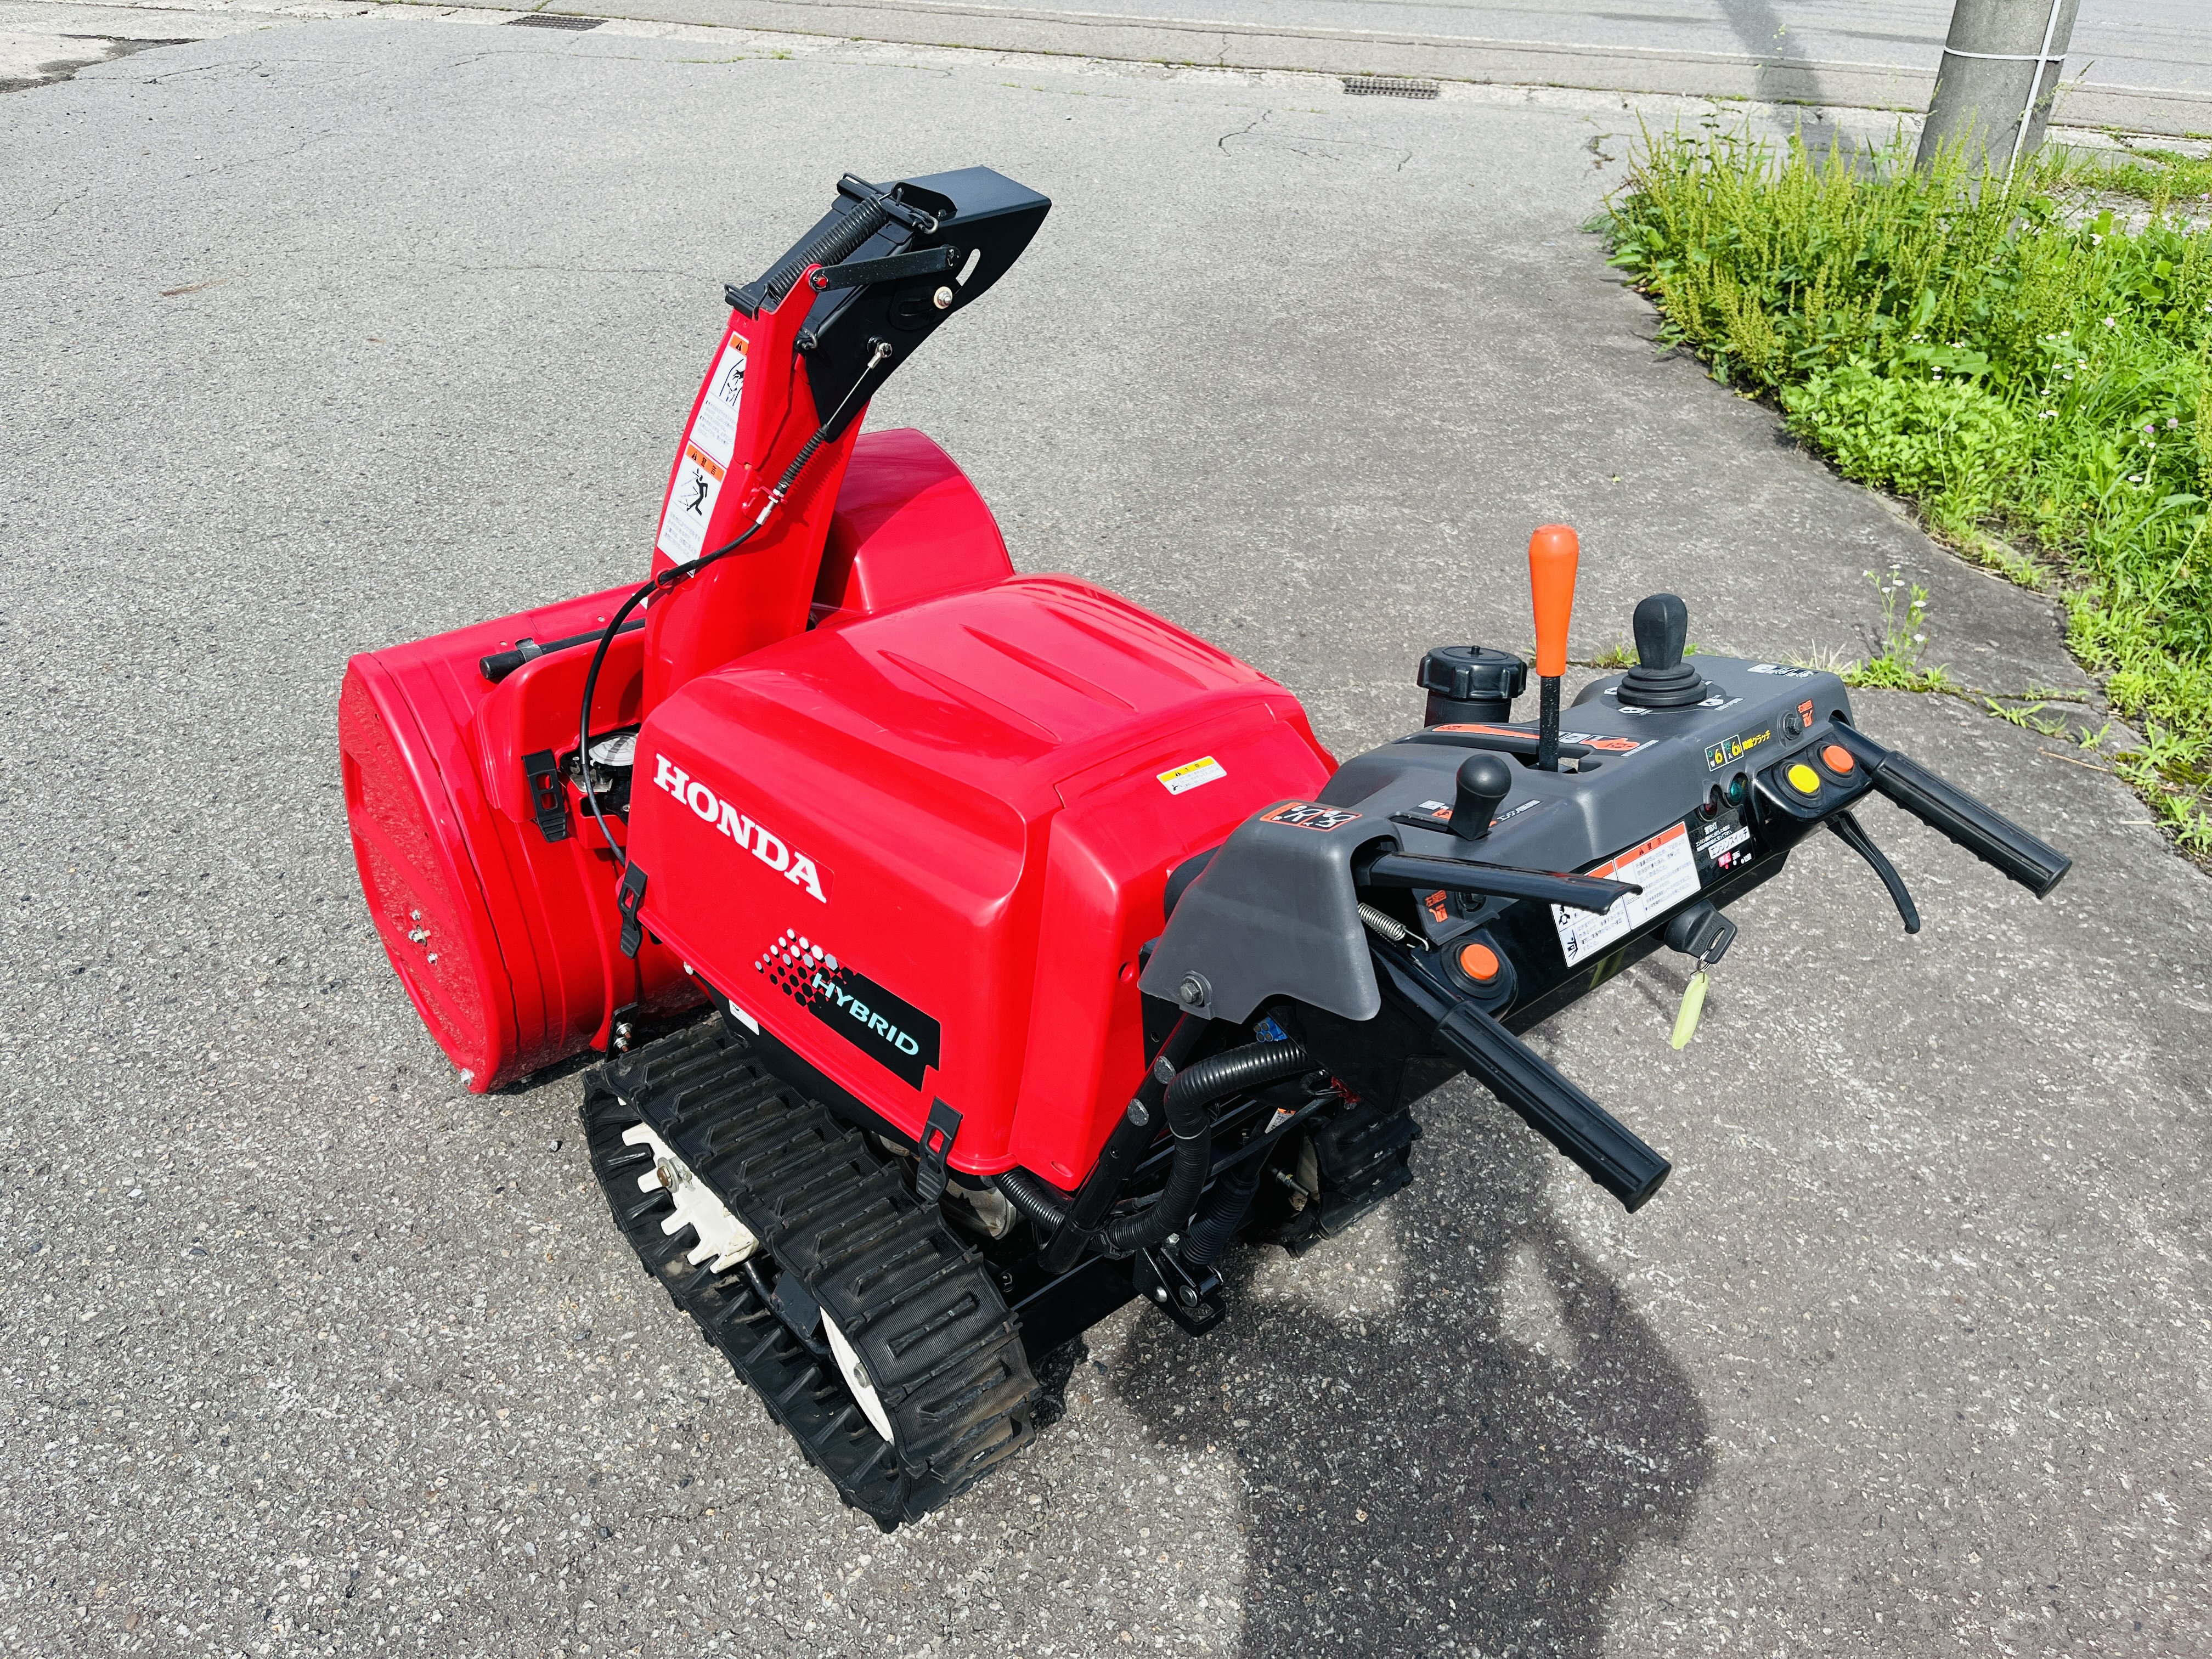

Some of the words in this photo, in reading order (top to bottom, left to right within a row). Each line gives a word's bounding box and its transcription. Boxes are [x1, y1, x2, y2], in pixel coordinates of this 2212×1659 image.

[653, 753, 827, 904] HONDA
[1711, 828, 1748, 857] エンジンスイッチ
[812, 972, 919, 1056] HYBRID
